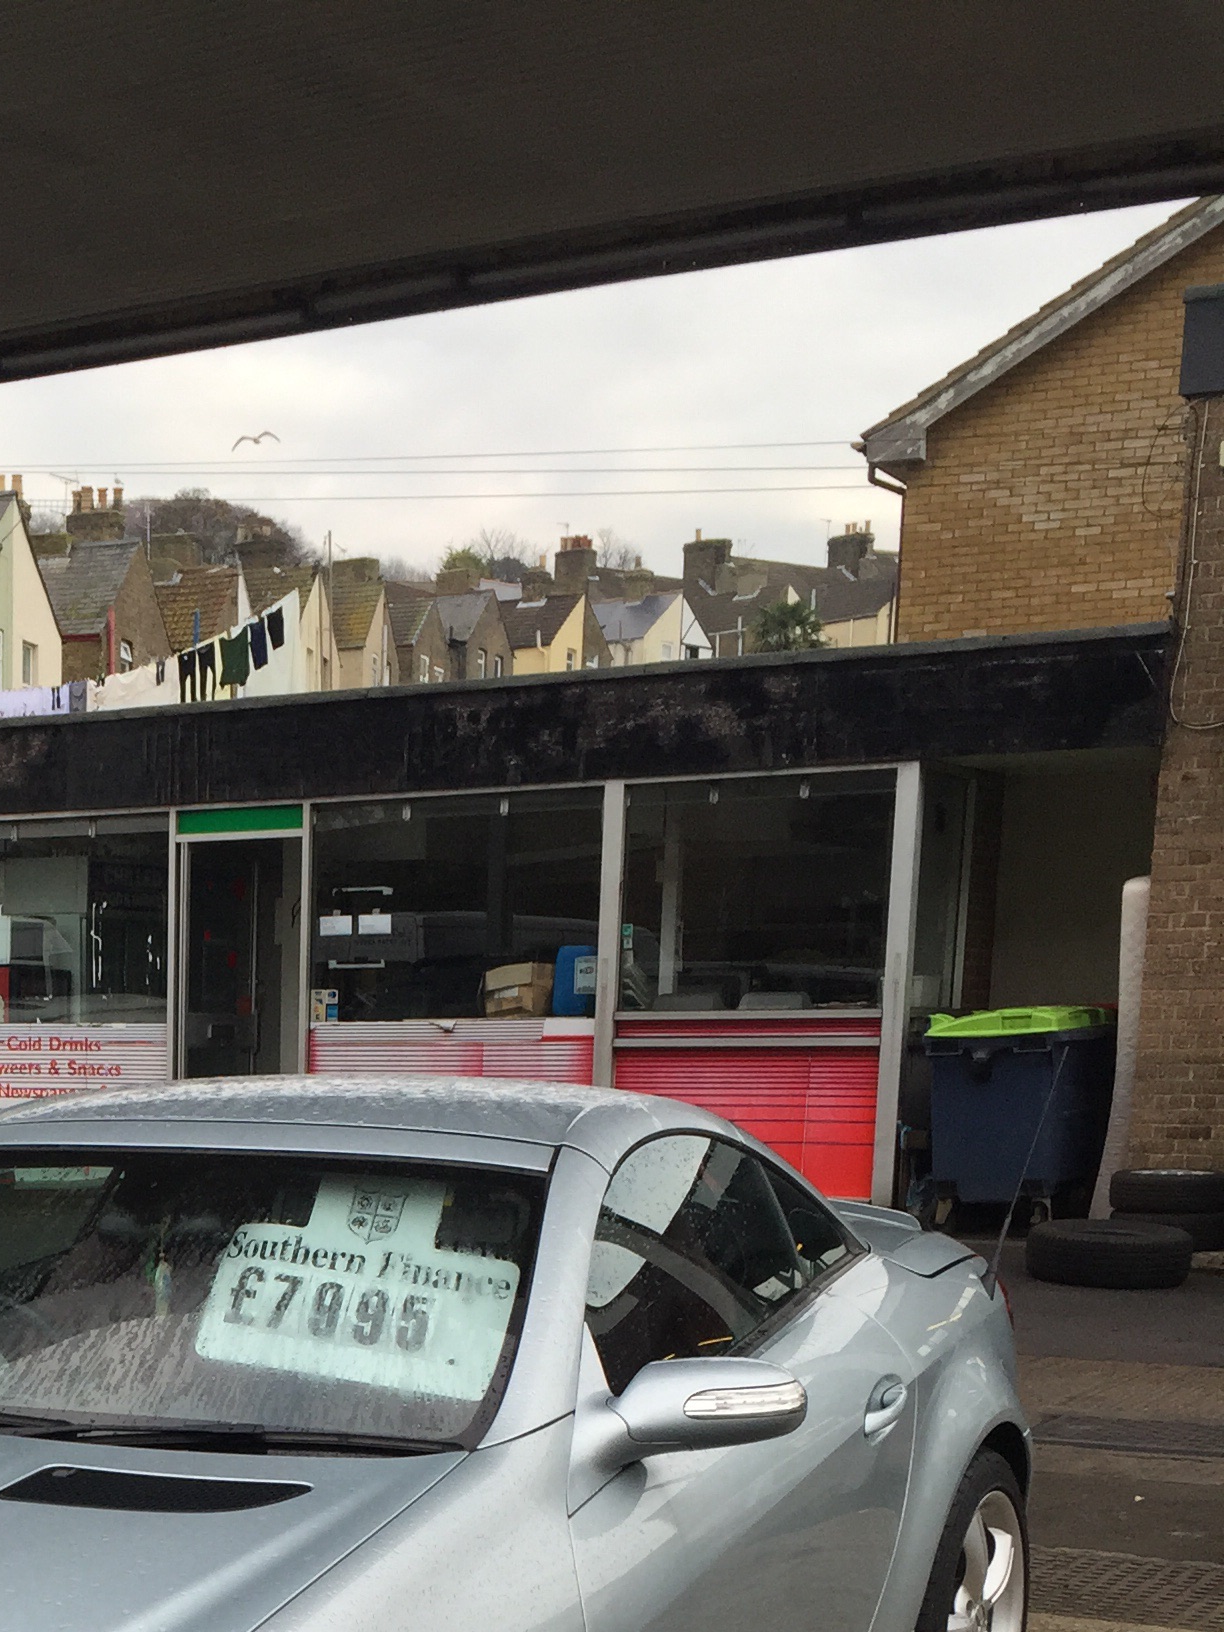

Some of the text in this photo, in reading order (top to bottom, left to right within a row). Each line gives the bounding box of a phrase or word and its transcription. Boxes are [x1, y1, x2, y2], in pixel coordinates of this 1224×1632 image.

[7, 1036, 102, 1052] Cold Drinks
[48, 1058, 60, 1075] &
[226, 1231, 367, 1275] Southern
